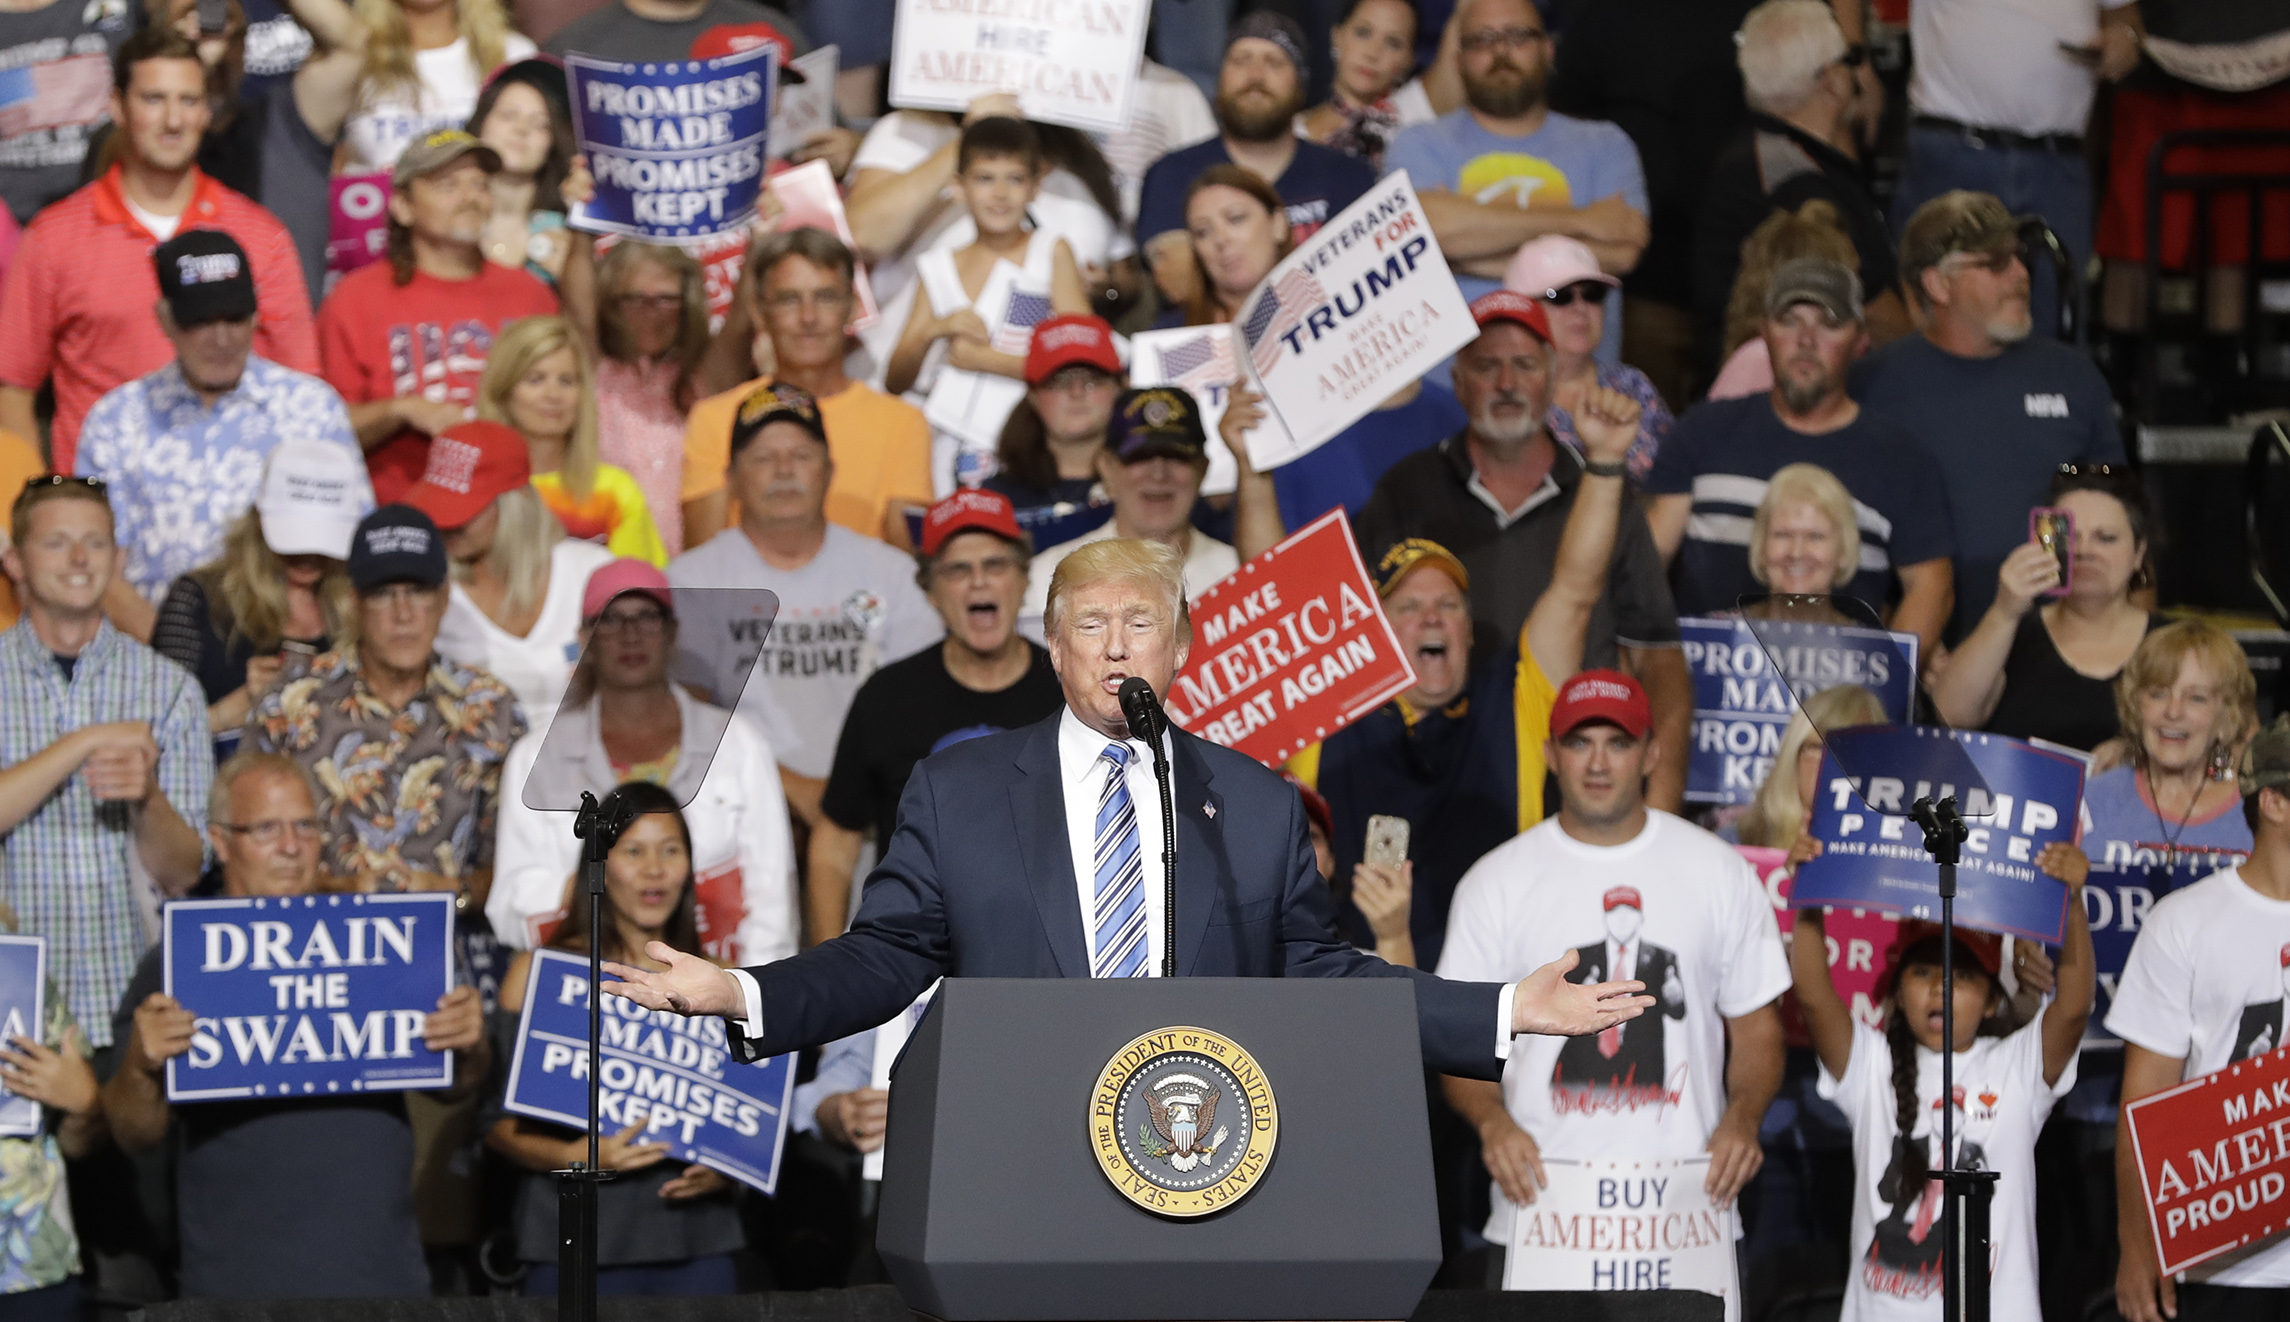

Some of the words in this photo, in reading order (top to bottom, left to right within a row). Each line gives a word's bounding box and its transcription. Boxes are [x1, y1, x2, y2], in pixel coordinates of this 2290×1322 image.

[976, 22, 1052, 56] HIRE
[585, 70, 763, 119] PROMISES
[909, 50, 1119, 103] AMERICAN
[620, 111, 735, 149] MADE
[592, 147, 761, 193] PROMISES
[631, 187, 729, 225] KEPT
[1302, 187, 1408, 276] VETERANS
[1373, 210, 1418, 252] FOR
[1281, 235, 1428, 356] TRUMP
[1317, 298, 1440, 400] AMERICA
[1202, 581, 1282, 647] MAKE
[1280, 633, 1377, 711] AGAIN
[1683, 639, 1891, 687] PROMISES
[1722, 676, 1817, 713] MAD
[1828, 841, 1866, 855] MAKE
[1839, 813, 2033, 864] PECE
[200, 916, 418, 973] DRAIN
[268, 973, 349, 1010] THE
[187, 1009, 428, 1070] SWAMP
[600, 1013, 727, 1080] MADE
[1183, 1034, 1200, 1047] OF
[1204, 1038, 1227, 1057] THE
[1096, 1033, 1177, 1118] PRESIDENT
[1231, 1054, 1271, 1132] UNITED
[1098, 1124, 1112, 1151] THE
[1106, 1153, 1121, 1170] OF
[1202, 1148, 1264, 1208] STATES
[1121, 1168, 1169, 1207] SEAL
[1598, 1177, 1669, 1209] BUY
[2166, 1171, 2286, 1239] PROUD
[1523, 1210, 1722, 1251] AMERICAN
[1593, 1257, 1672, 1290] HIRE
